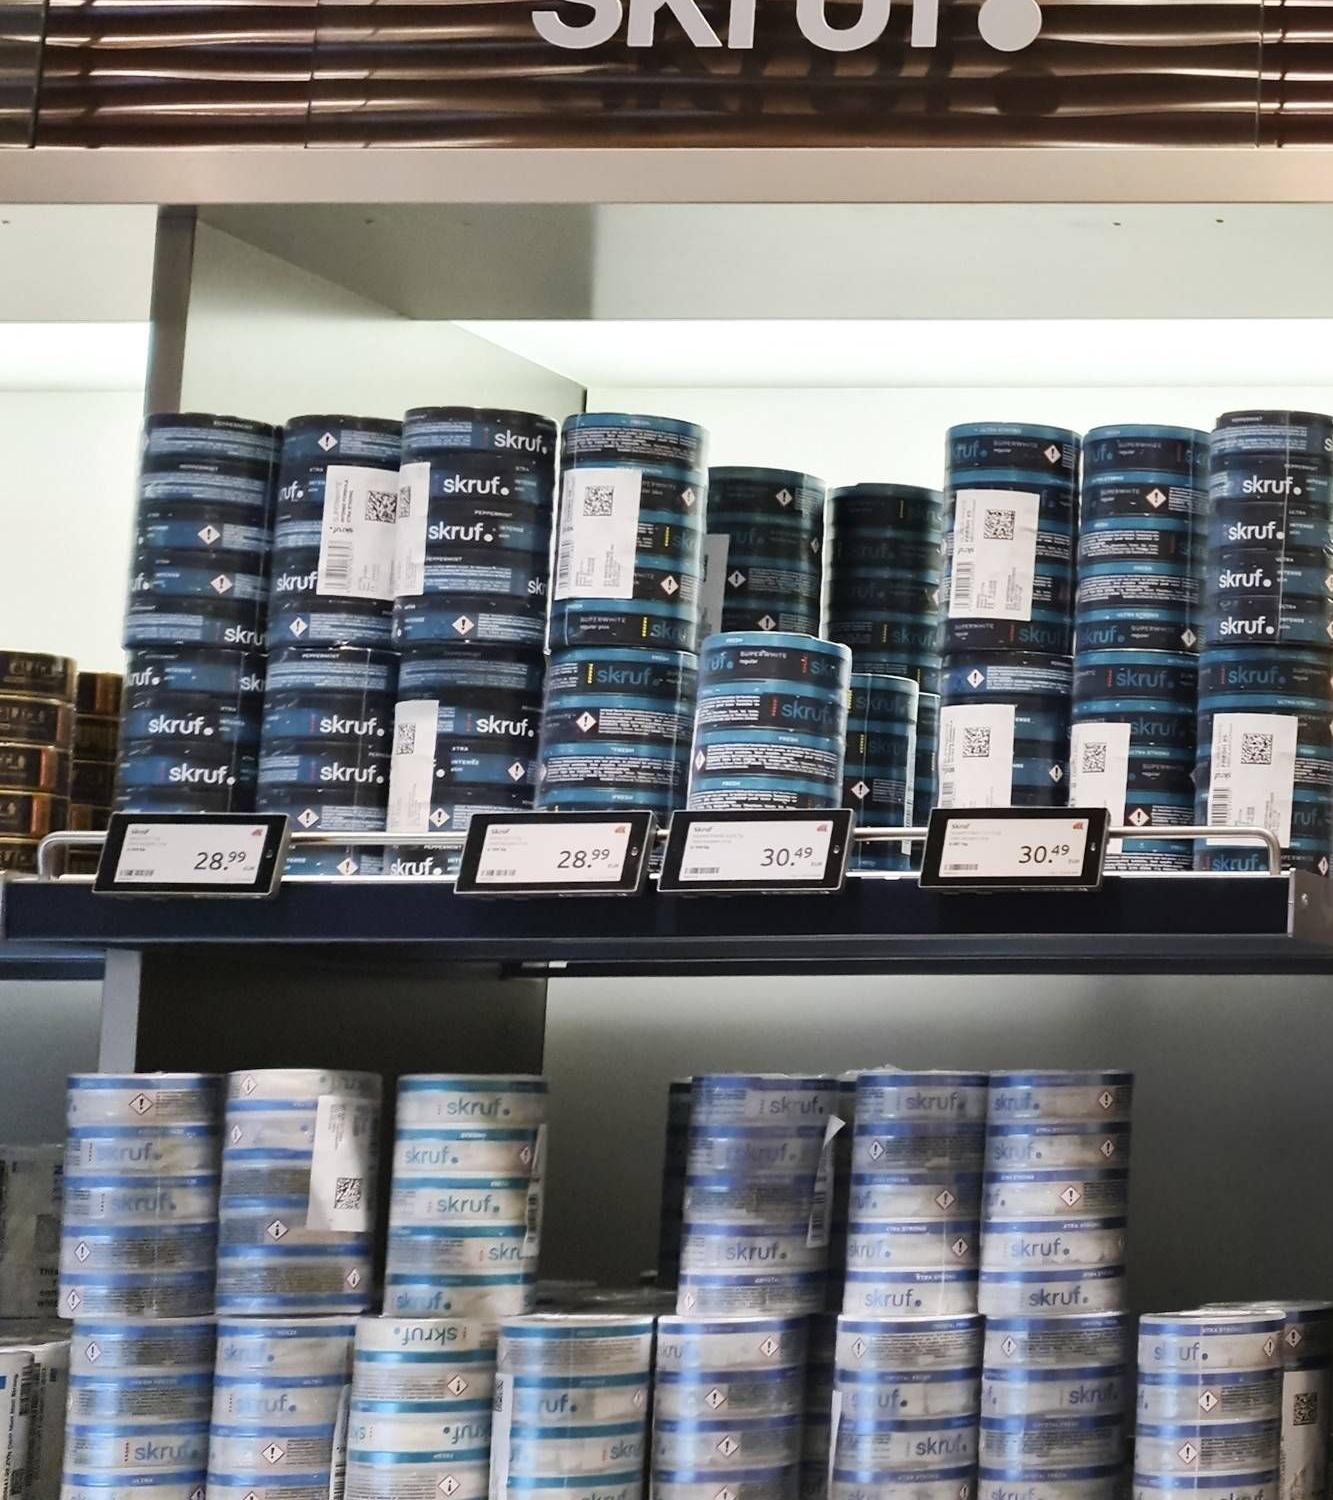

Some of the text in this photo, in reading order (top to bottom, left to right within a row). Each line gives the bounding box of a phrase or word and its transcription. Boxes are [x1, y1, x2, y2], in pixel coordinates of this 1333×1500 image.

[194, 852, 246, 870] 28.99
[557, 849, 610, 868] 28.99
[761, 847, 813, 866] 30.49
[1019, 845, 1070, 863] 30.49
